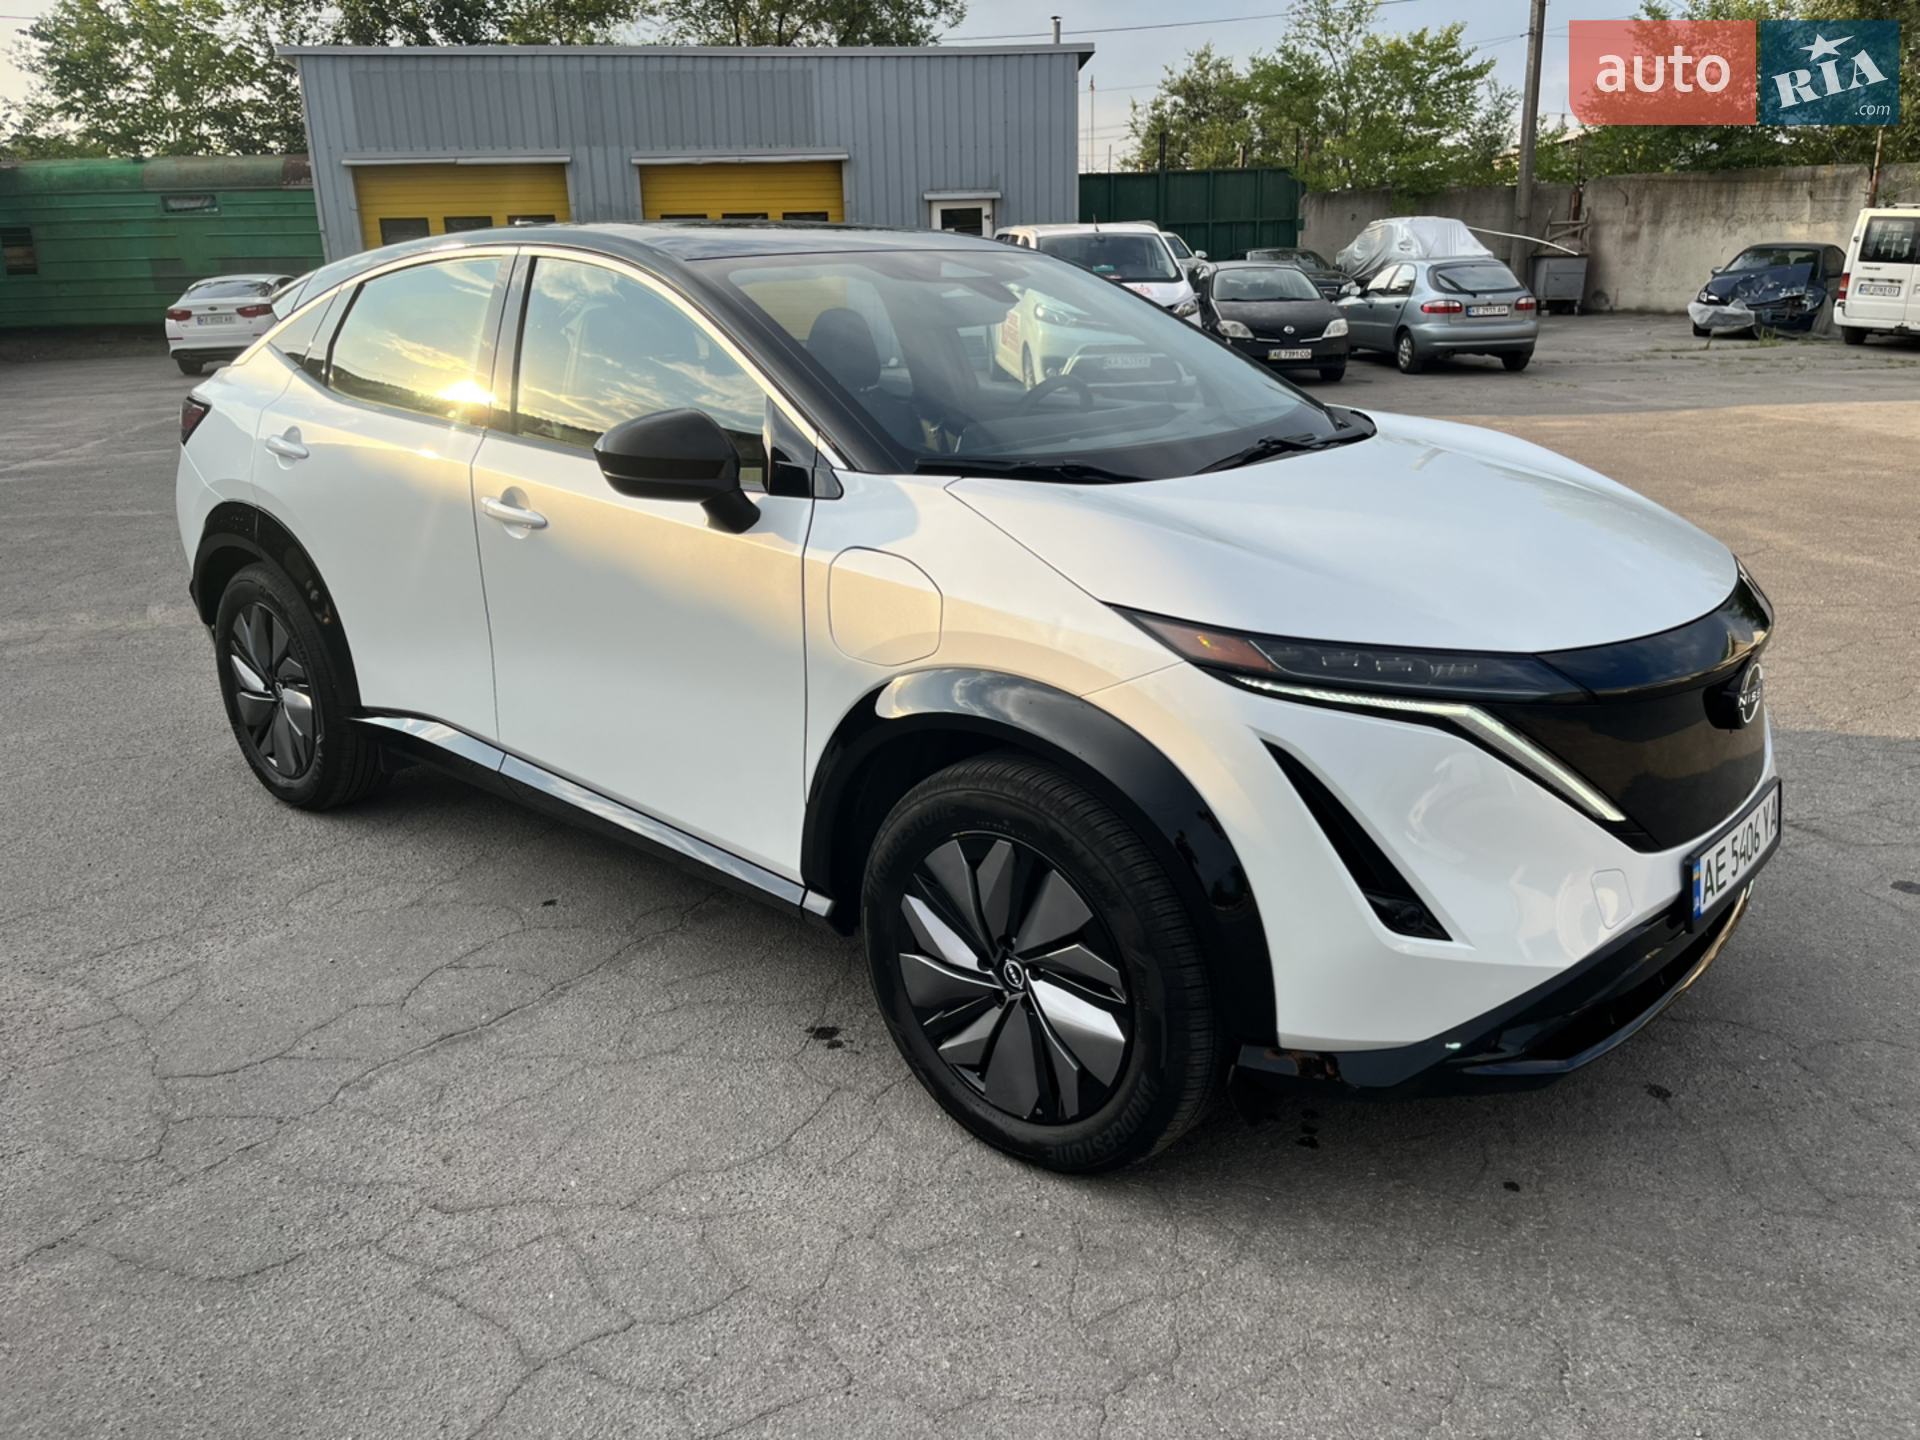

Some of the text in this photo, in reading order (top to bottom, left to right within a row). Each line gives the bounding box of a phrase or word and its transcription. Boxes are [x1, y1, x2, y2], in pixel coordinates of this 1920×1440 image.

[1703, 795, 1777, 905] AE 5406 YA
[1046, 1070, 1160, 1166] BRIDGESTONE
